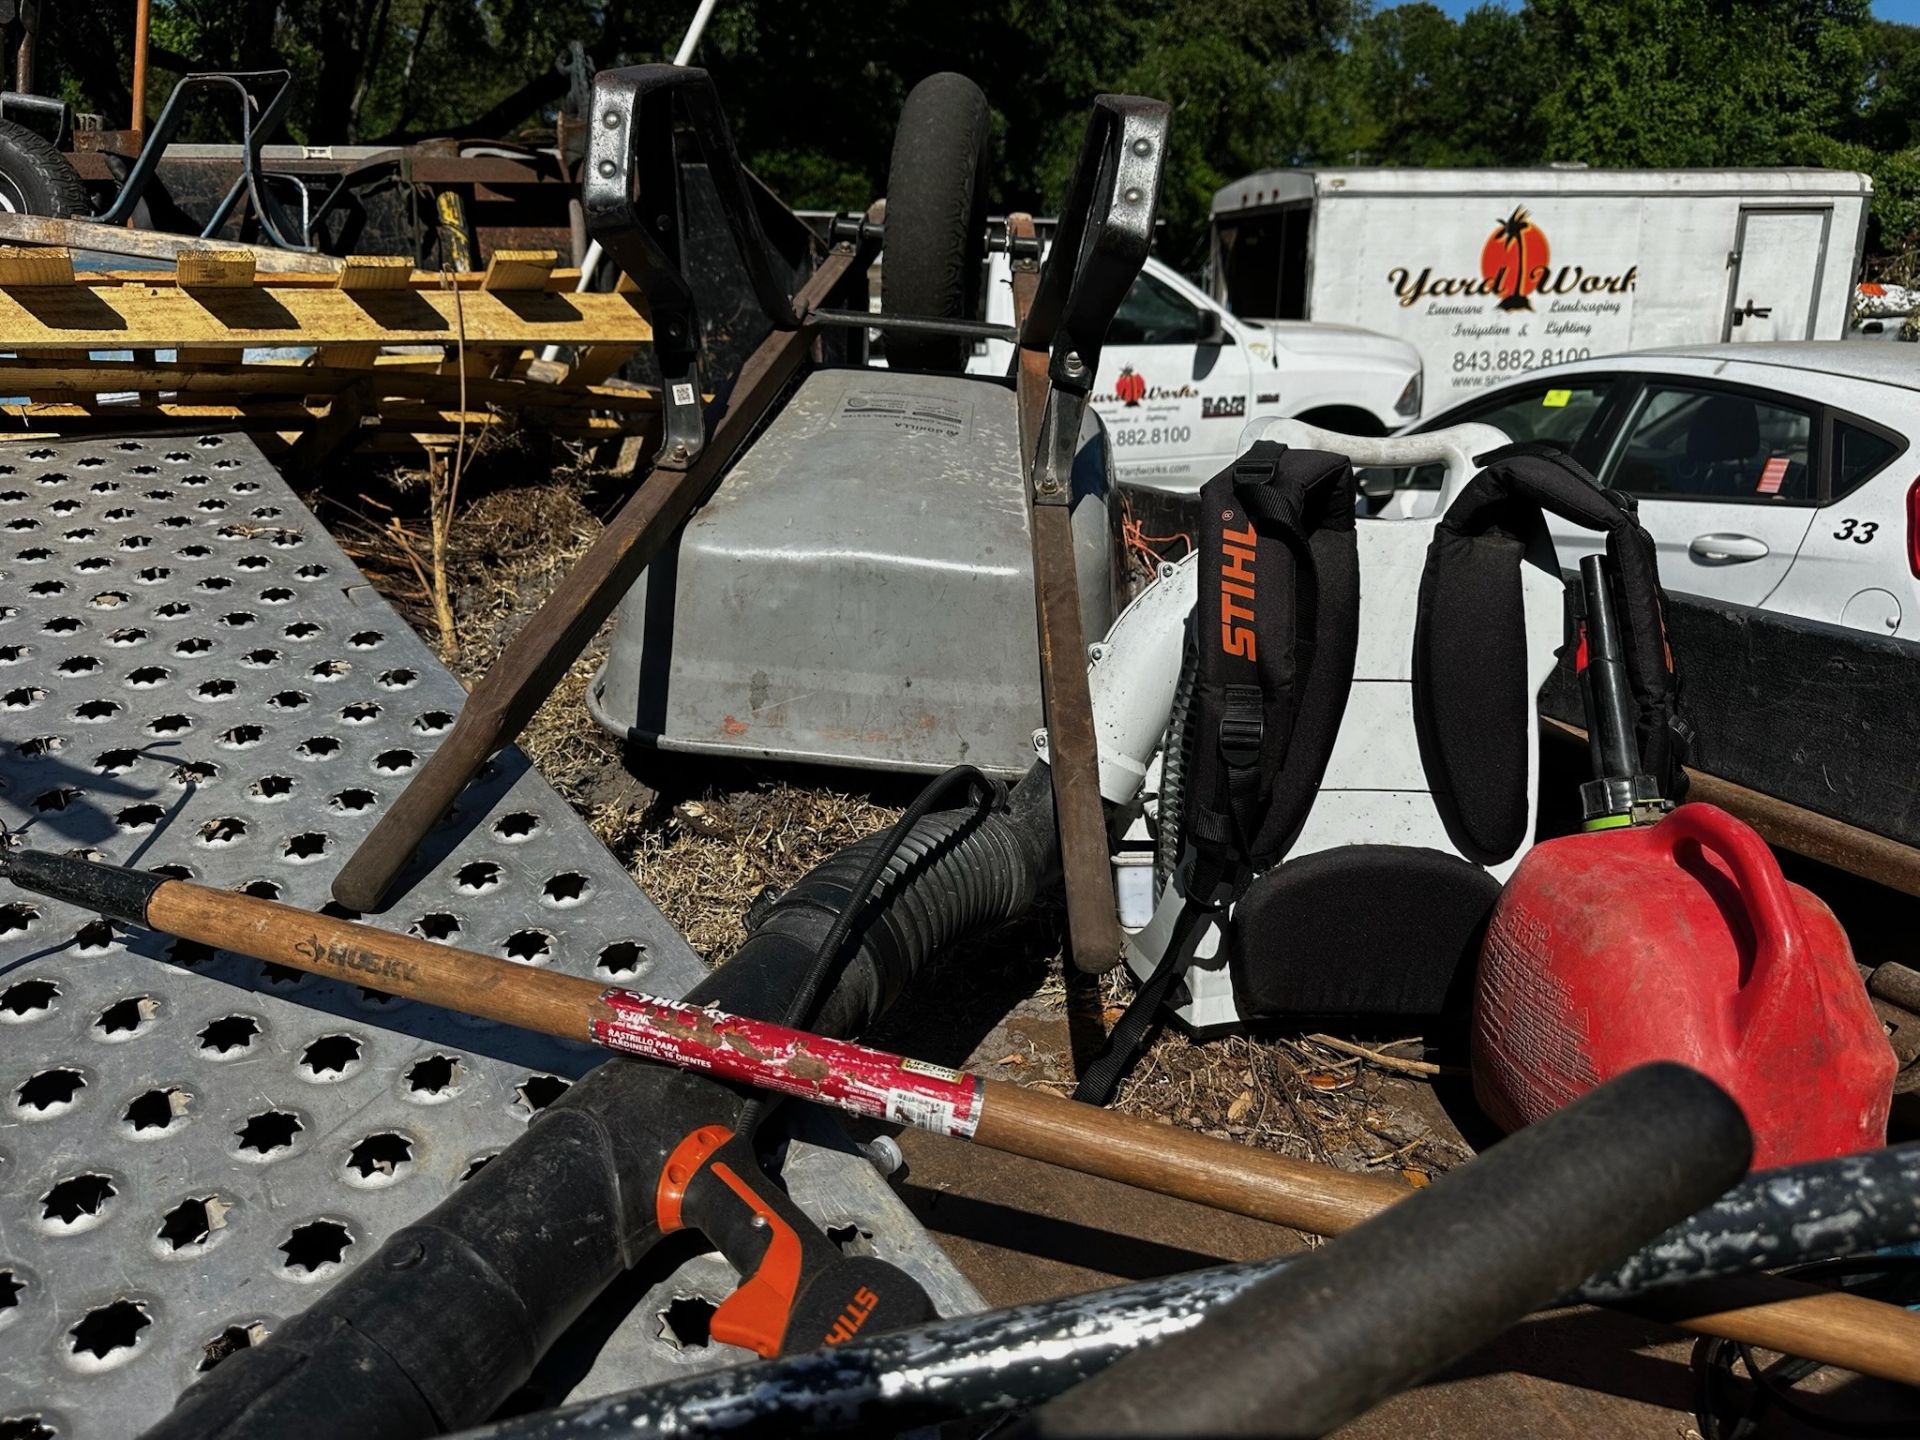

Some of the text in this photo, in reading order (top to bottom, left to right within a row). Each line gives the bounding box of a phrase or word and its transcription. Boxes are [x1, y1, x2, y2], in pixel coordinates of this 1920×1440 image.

[1387, 266, 1508, 308] Yard
[1425, 299, 1621, 316] Lawncare Landscaping
[1451, 320, 1592, 339] Irrigation & Lighting
[1452, 347, 1591, 373] 843.882.8100
[1833, 518, 1879, 544] 33
[1221, 522, 1258, 662] STIHL
[607, 1027, 655, 1047] RASTRILLO
[655, 1040, 680, 1053] PARA
[676, 1054, 712, 1069] DIENTES
[824, 1285, 880, 1345] STIH
